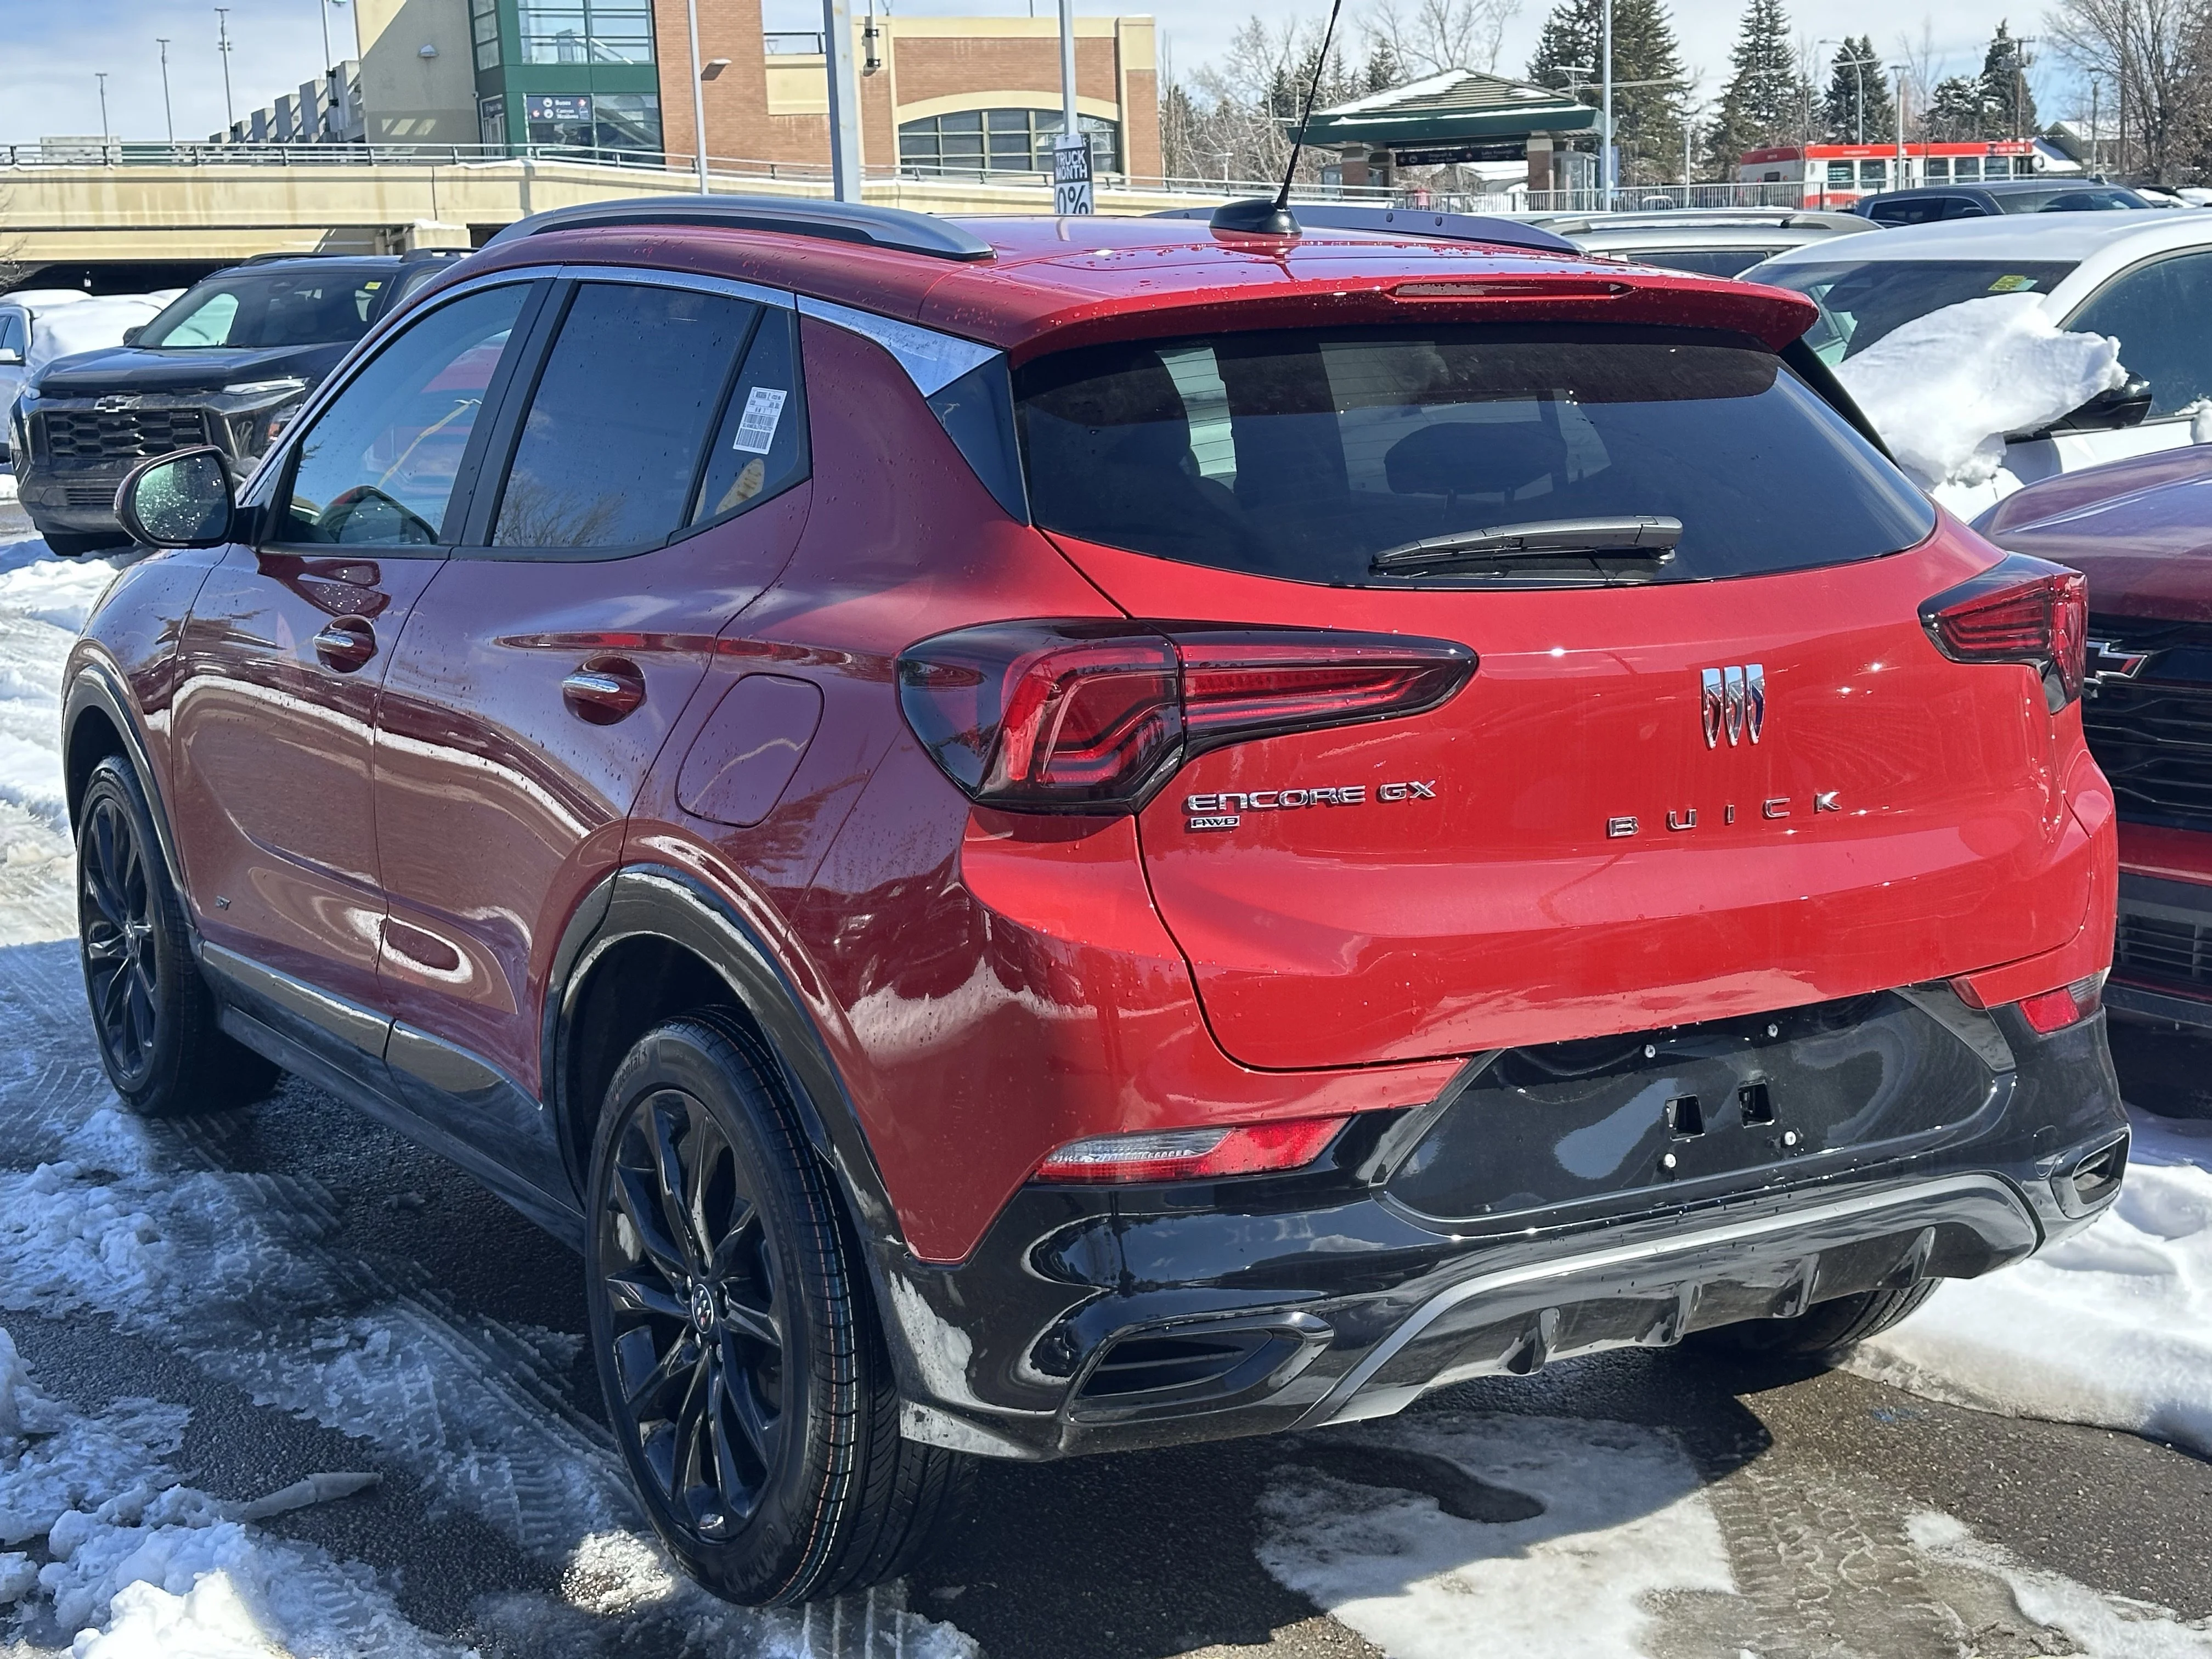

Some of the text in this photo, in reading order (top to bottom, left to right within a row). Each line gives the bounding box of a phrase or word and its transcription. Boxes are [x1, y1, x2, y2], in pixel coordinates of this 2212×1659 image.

[1055, 150, 1086, 166] TRUCK
[1056, 165, 1088, 181] MONTH
[1057, 184, 1089, 215] 0%
[1187, 780, 1437, 811] ENCORE GX
[1191, 816, 1239, 827] AWD
[1608, 790, 1842, 837] BUICK
